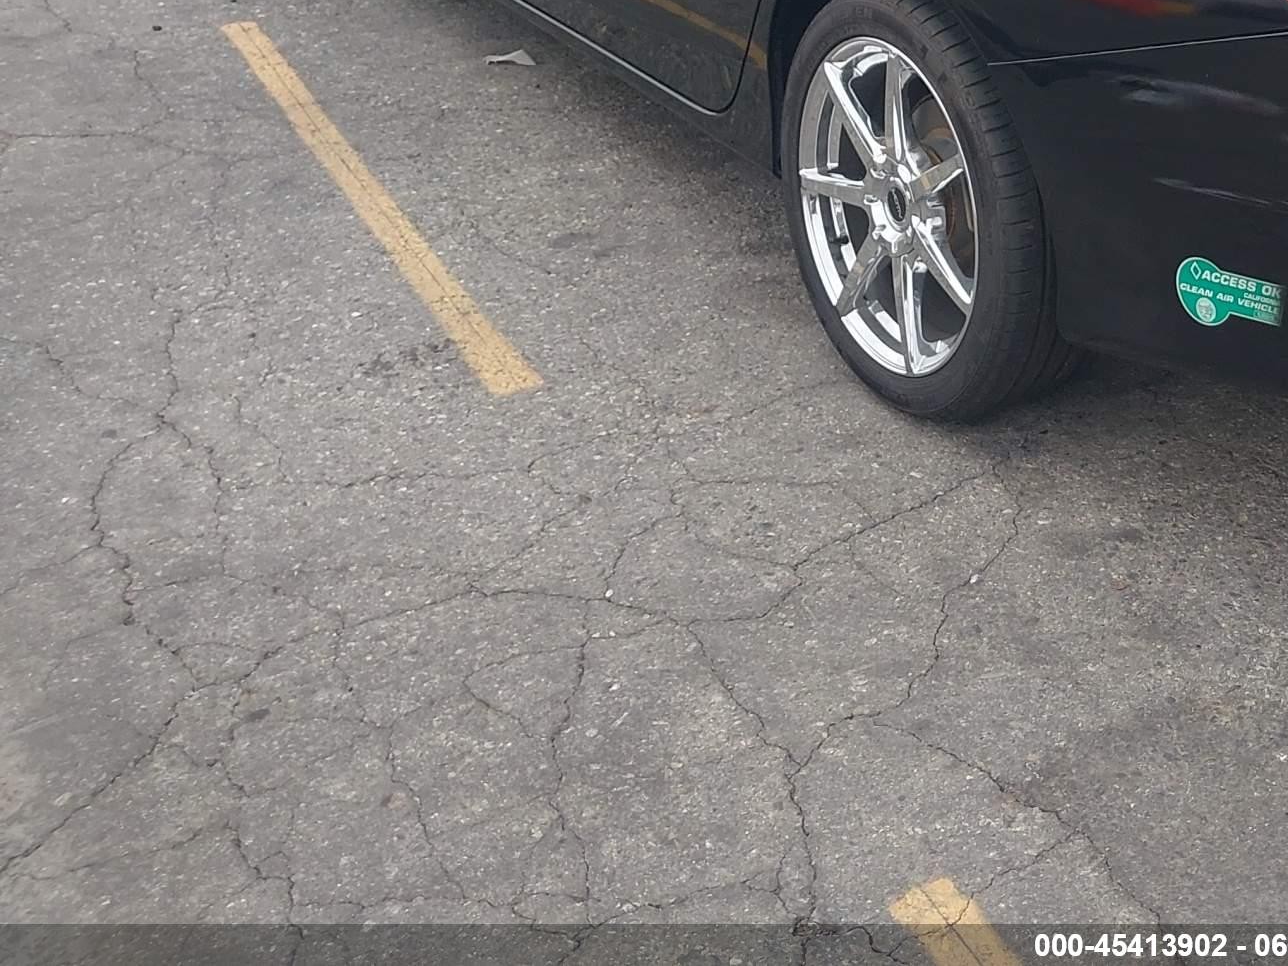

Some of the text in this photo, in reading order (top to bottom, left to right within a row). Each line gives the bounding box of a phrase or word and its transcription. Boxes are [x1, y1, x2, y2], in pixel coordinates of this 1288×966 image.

[1180, 282, 1280, 315] CLEAN AIR VEHICLE
[1201, 270, 1281, 299] ACCESS OK
